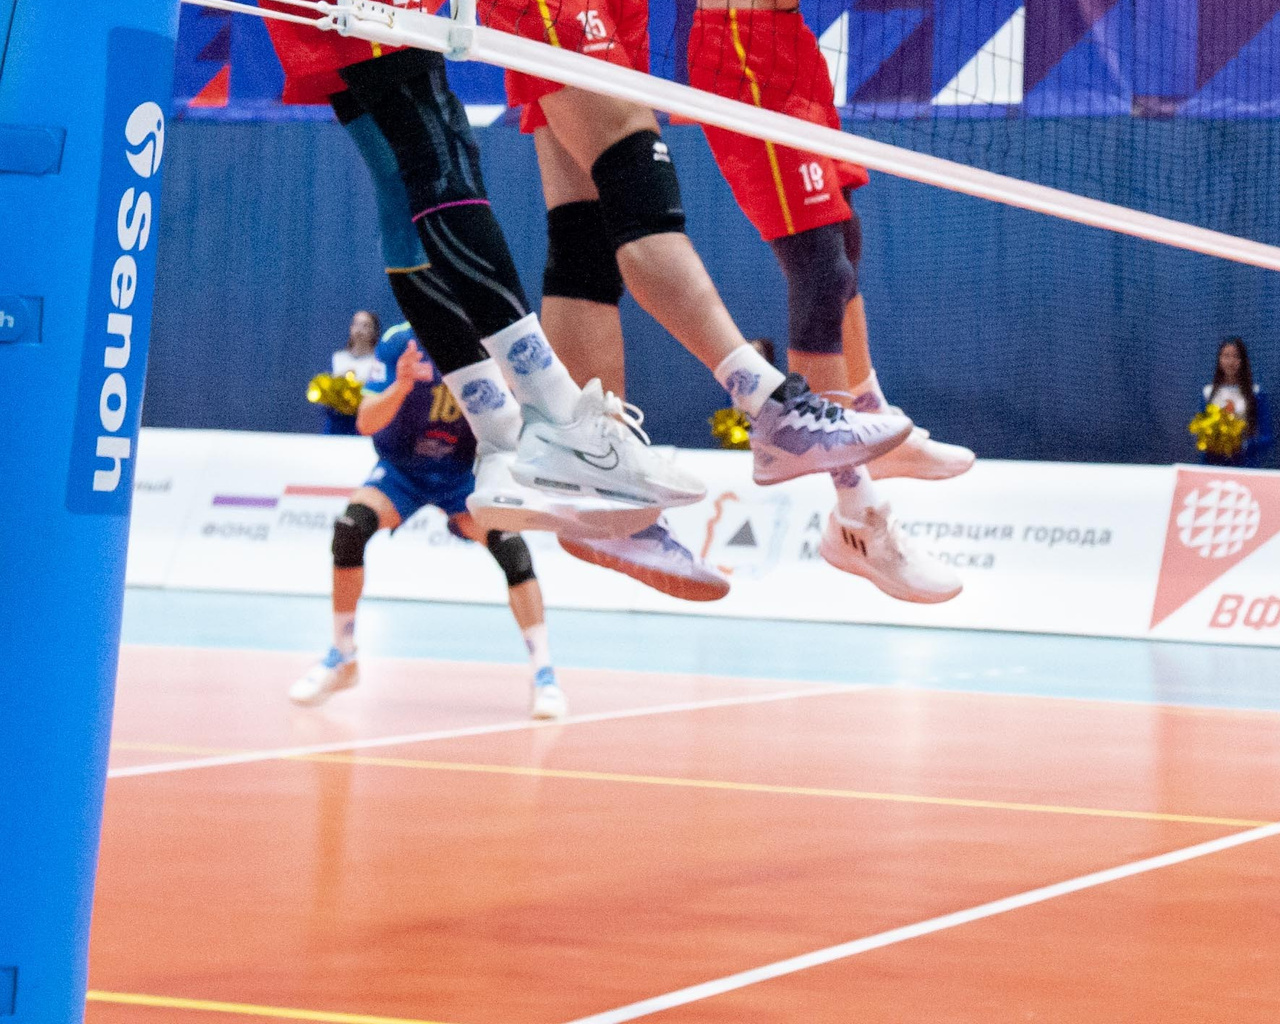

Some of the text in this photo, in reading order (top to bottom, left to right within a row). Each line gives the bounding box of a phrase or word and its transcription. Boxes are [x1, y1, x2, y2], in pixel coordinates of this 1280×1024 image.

[576, 10, 607, 41] 15
[798, 162, 824, 192] 19
[93, 187, 152, 492] Senoh
[1022, 524, 1112, 548] города
